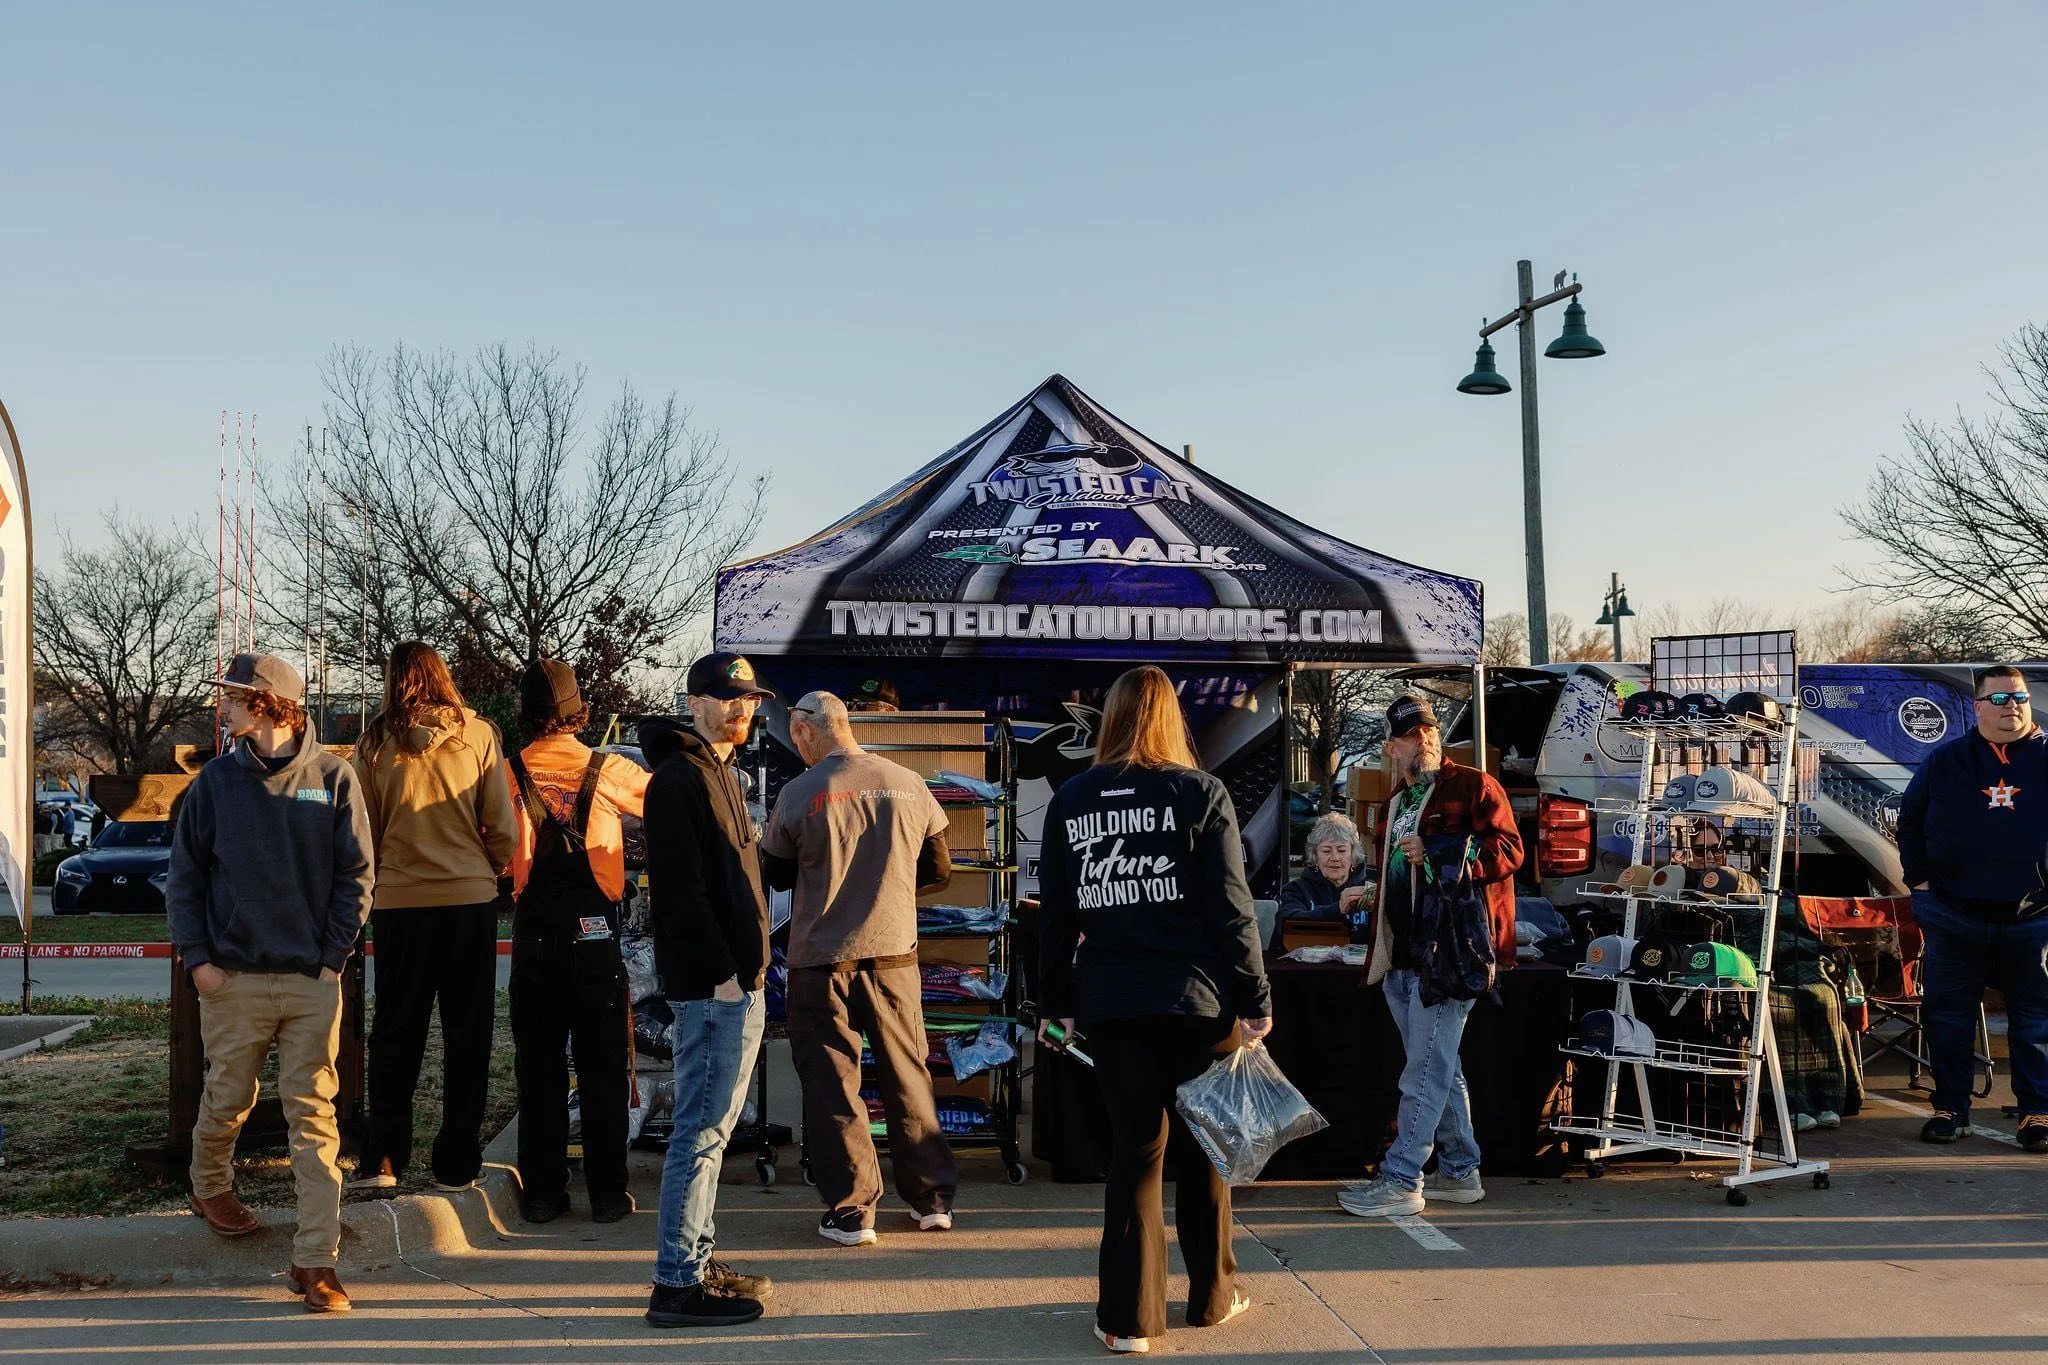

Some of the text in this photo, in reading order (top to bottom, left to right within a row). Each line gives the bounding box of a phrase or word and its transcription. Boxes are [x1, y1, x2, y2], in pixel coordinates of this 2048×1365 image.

[969, 475, 1192, 505] TWISTED CAT
[1024, 487, 1138, 508] Outdoors
[928, 521, 1101, 539] PRESENTED BY
[1021, 537, 1236, 564] SEAARK
[1211, 562, 1267, 571] BOATS
[826, 600, 1383, 644] TWISTEDCATOUTDOORS.COM
[1821, 685, 1864, 694] PURPOSE
[1825, 700, 1859, 708] OPTICS
[859, 789, 915, 801] PLUMBING
[1989, 786, 2014, 806] H
[1066, 806, 1176, 843] BUILDING A
[1073, 835, 1176, 888] Future
[1077, 877, 1184, 909] AROUND YOU.
[1, 946, 144, 957] FIRE LANE NO PARKING
